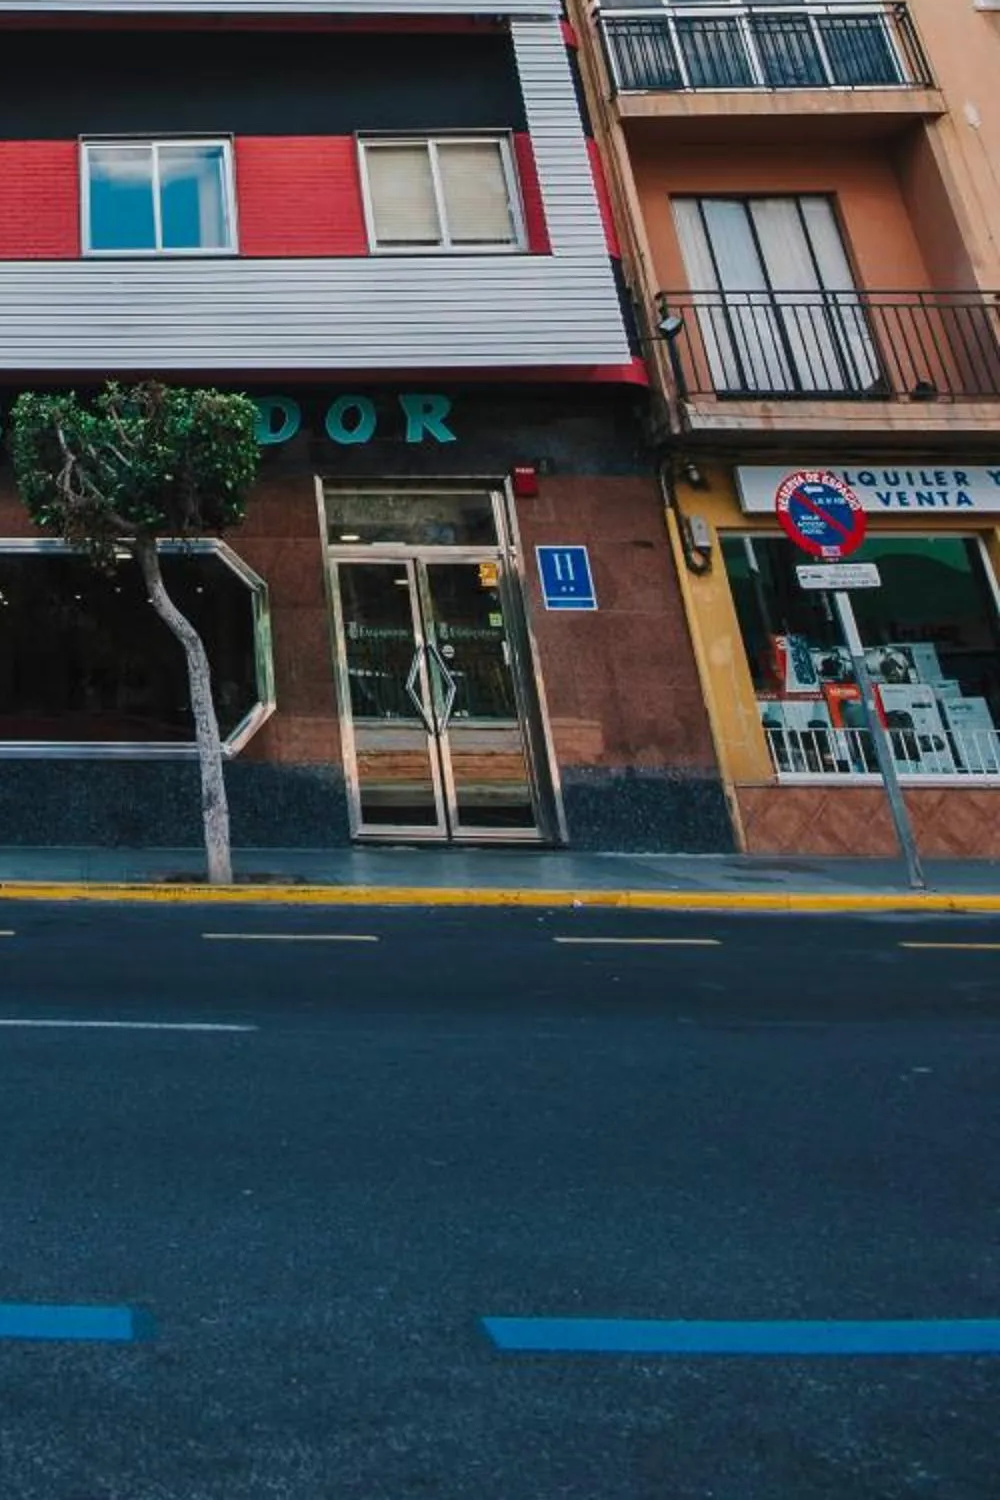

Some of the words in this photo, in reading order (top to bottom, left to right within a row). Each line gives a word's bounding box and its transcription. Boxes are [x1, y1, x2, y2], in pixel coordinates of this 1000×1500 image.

[805, 472, 820, 483] DE
[821, 474, 864, 512] ESPACIO
[875, 490, 975, 507] VENTA
